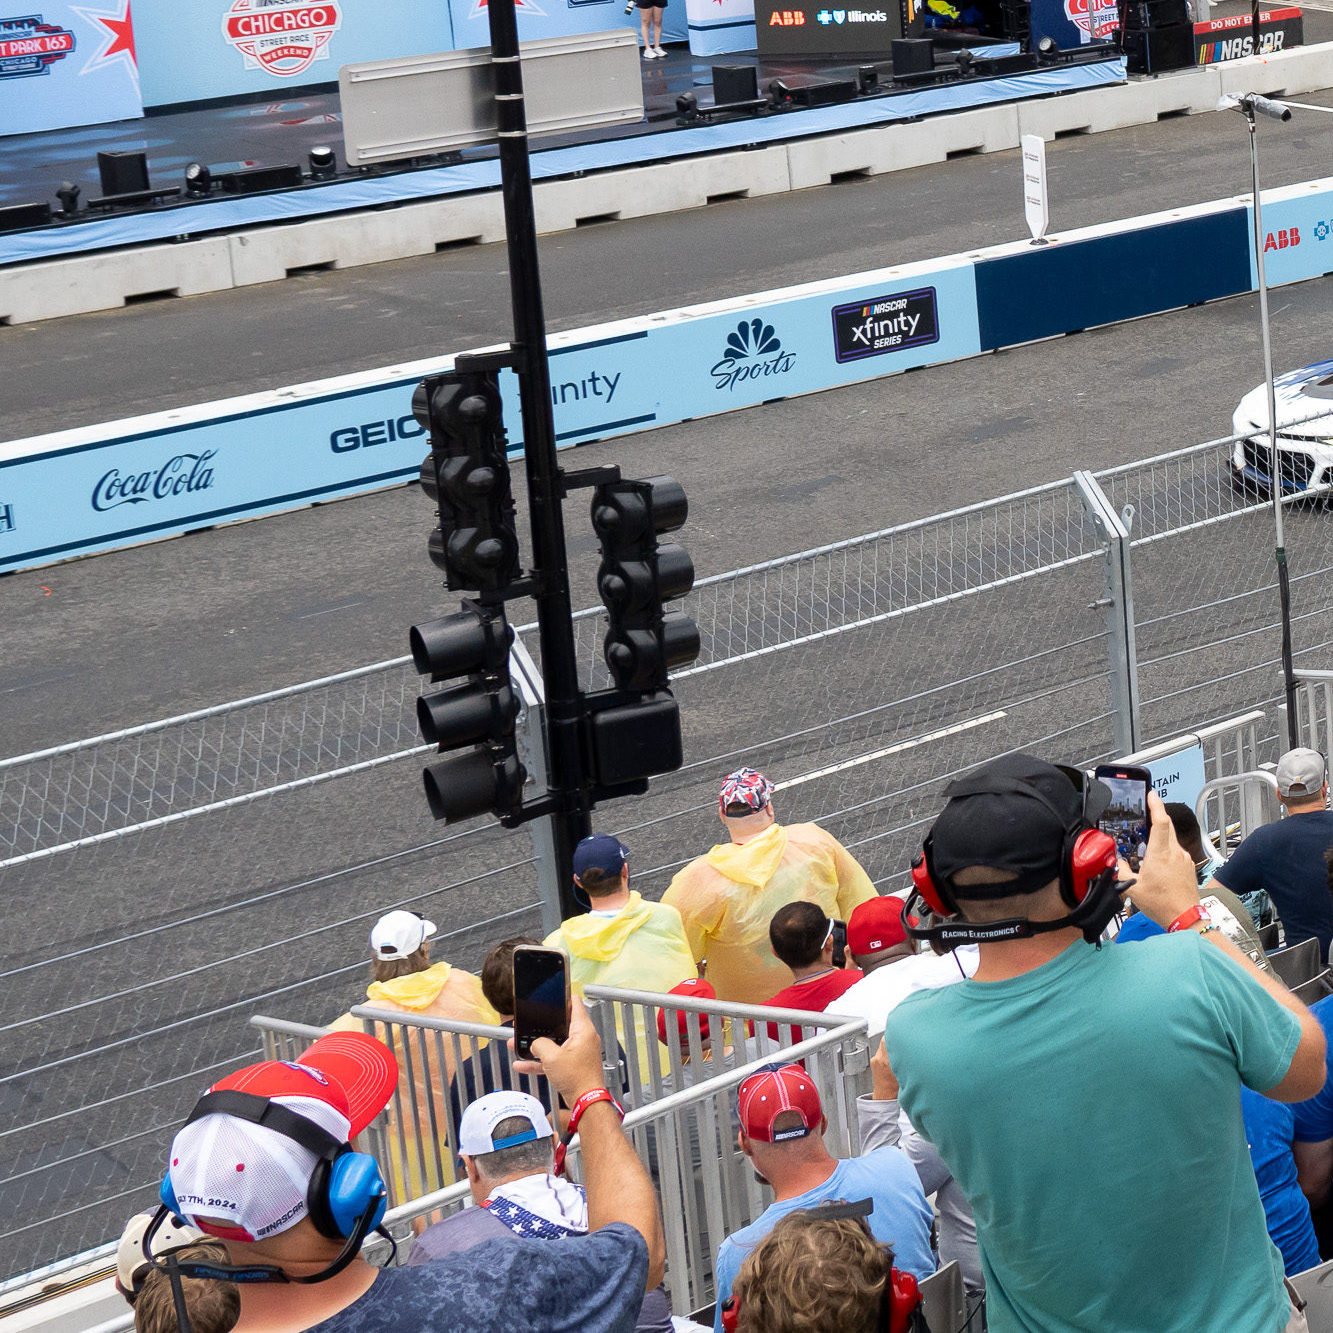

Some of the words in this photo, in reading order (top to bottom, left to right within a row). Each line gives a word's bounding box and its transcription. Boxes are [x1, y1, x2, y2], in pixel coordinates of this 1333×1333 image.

[237, 9, 327, 35] CHICAGO
[769, 10, 805, 26] ABB
[848, 9, 887, 23] Illinois
[1210, 21, 1222, 30] DO
[1225, 19, 1242, 28] NOT
[10, 40, 41, 53] PARK
[46, 37, 67, 49] 165
[259, 37, 288, 48] STREET
[290, 34, 310, 44] RACE
[264, 46, 310, 62] WEEKEND
[1264, 227, 1301, 253] ABB
[874, 298, 908, 315] NASCAR
[851, 311, 921, 346] xfinity
[873, 334, 903, 350] SERIES
[710, 350, 797, 392] Sports
[330, 412, 424, 454] GEIC
[91, 447, 220, 513] Coca-Cola
[942, 930, 968, 939] RACING
[969, 927, 1015, 938] ELECTRONICS
[187, 1196, 207, 1207] 7TH,
[207, 1198, 237, 1210] 2024
[268, 1201, 304, 1235] NASCAR
